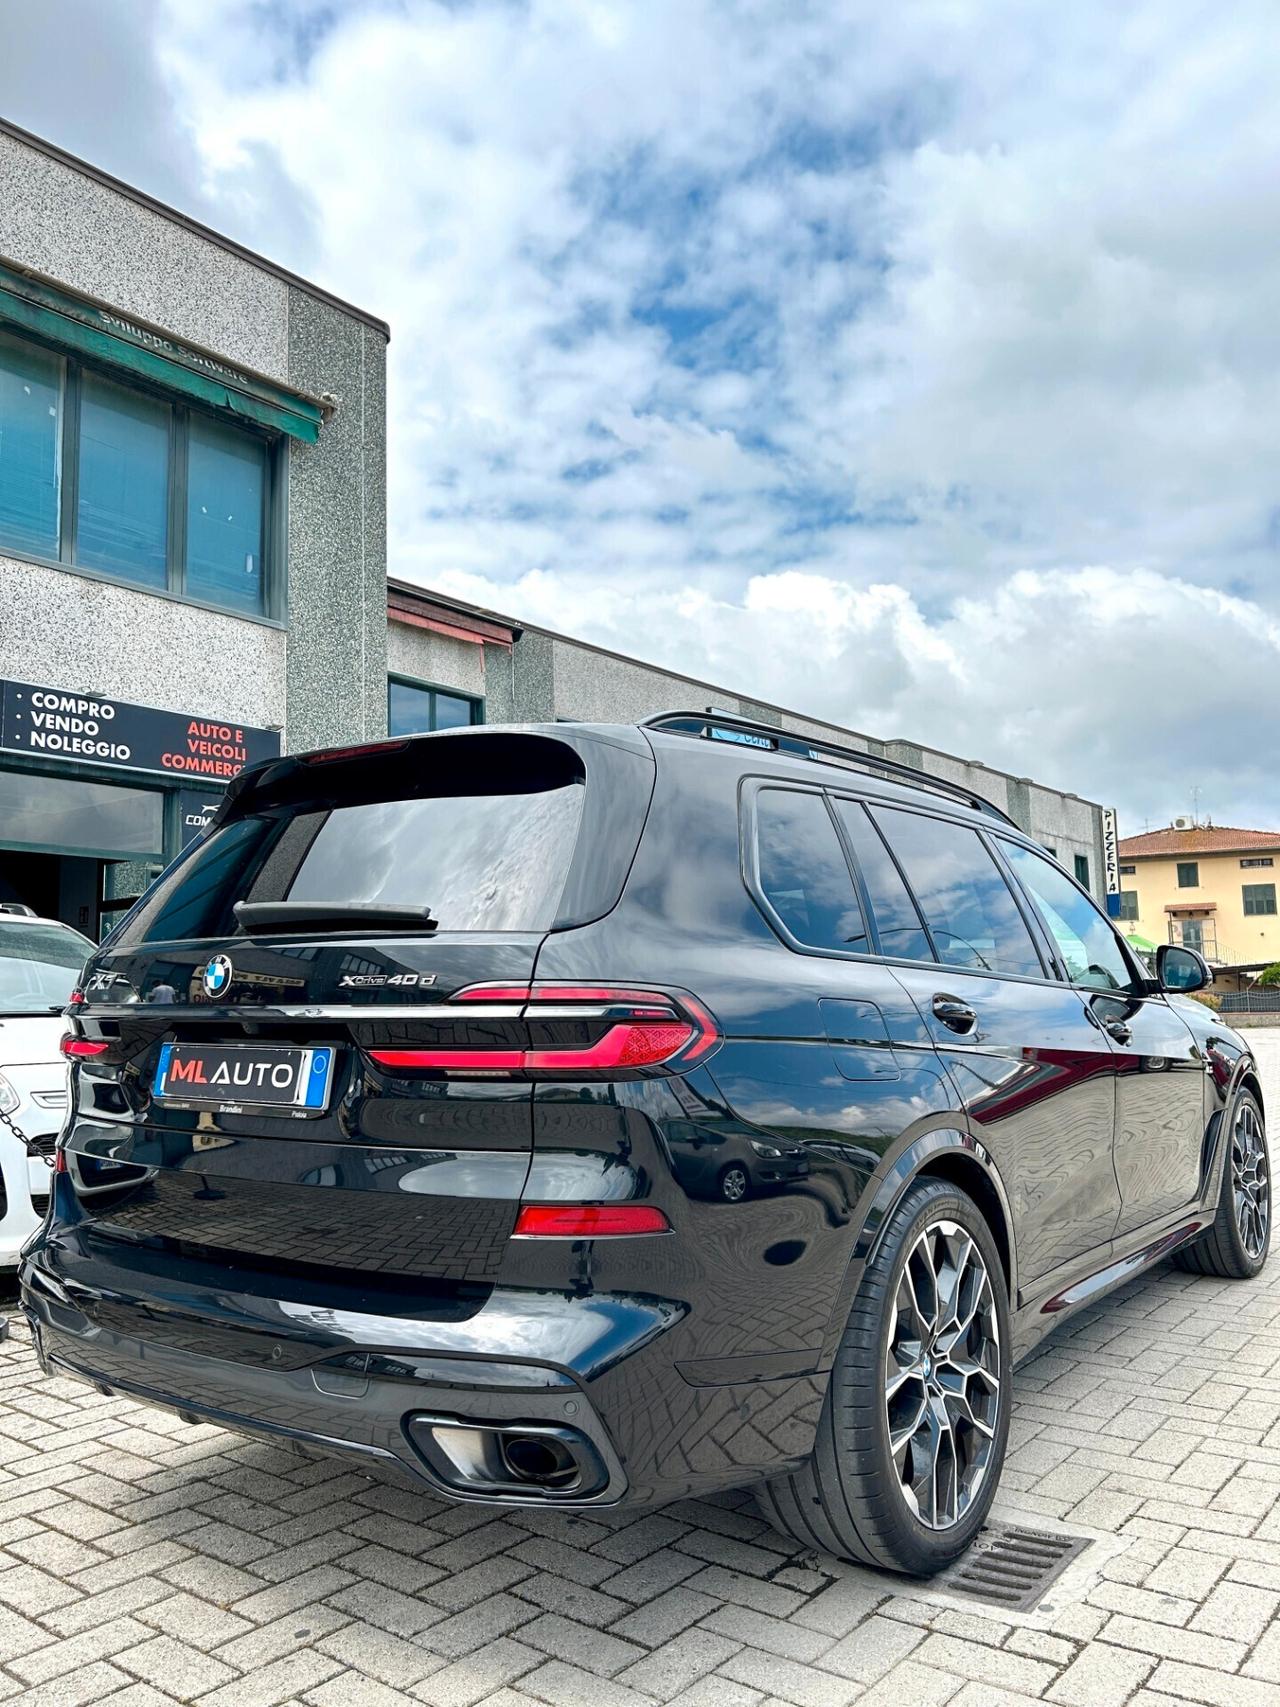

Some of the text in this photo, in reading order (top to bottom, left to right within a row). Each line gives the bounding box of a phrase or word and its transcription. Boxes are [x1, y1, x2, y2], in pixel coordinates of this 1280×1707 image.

[99, 311, 174, 352] Sviluppo
[31, 692, 115, 720] COMPRO
[30, 710, 99, 736] VENDO
[187, 721, 244, 744] AUTO E
[30, 730, 131, 760] NOLEGGIO
[187, 739, 246, 761] VEICOLI
[161, 753, 245, 777] COMMERC
[1104, 810, 1117, 892] PIZZERIA
[90, 973, 118, 990] X7
[219, 1104, 243, 1113] Brandini
